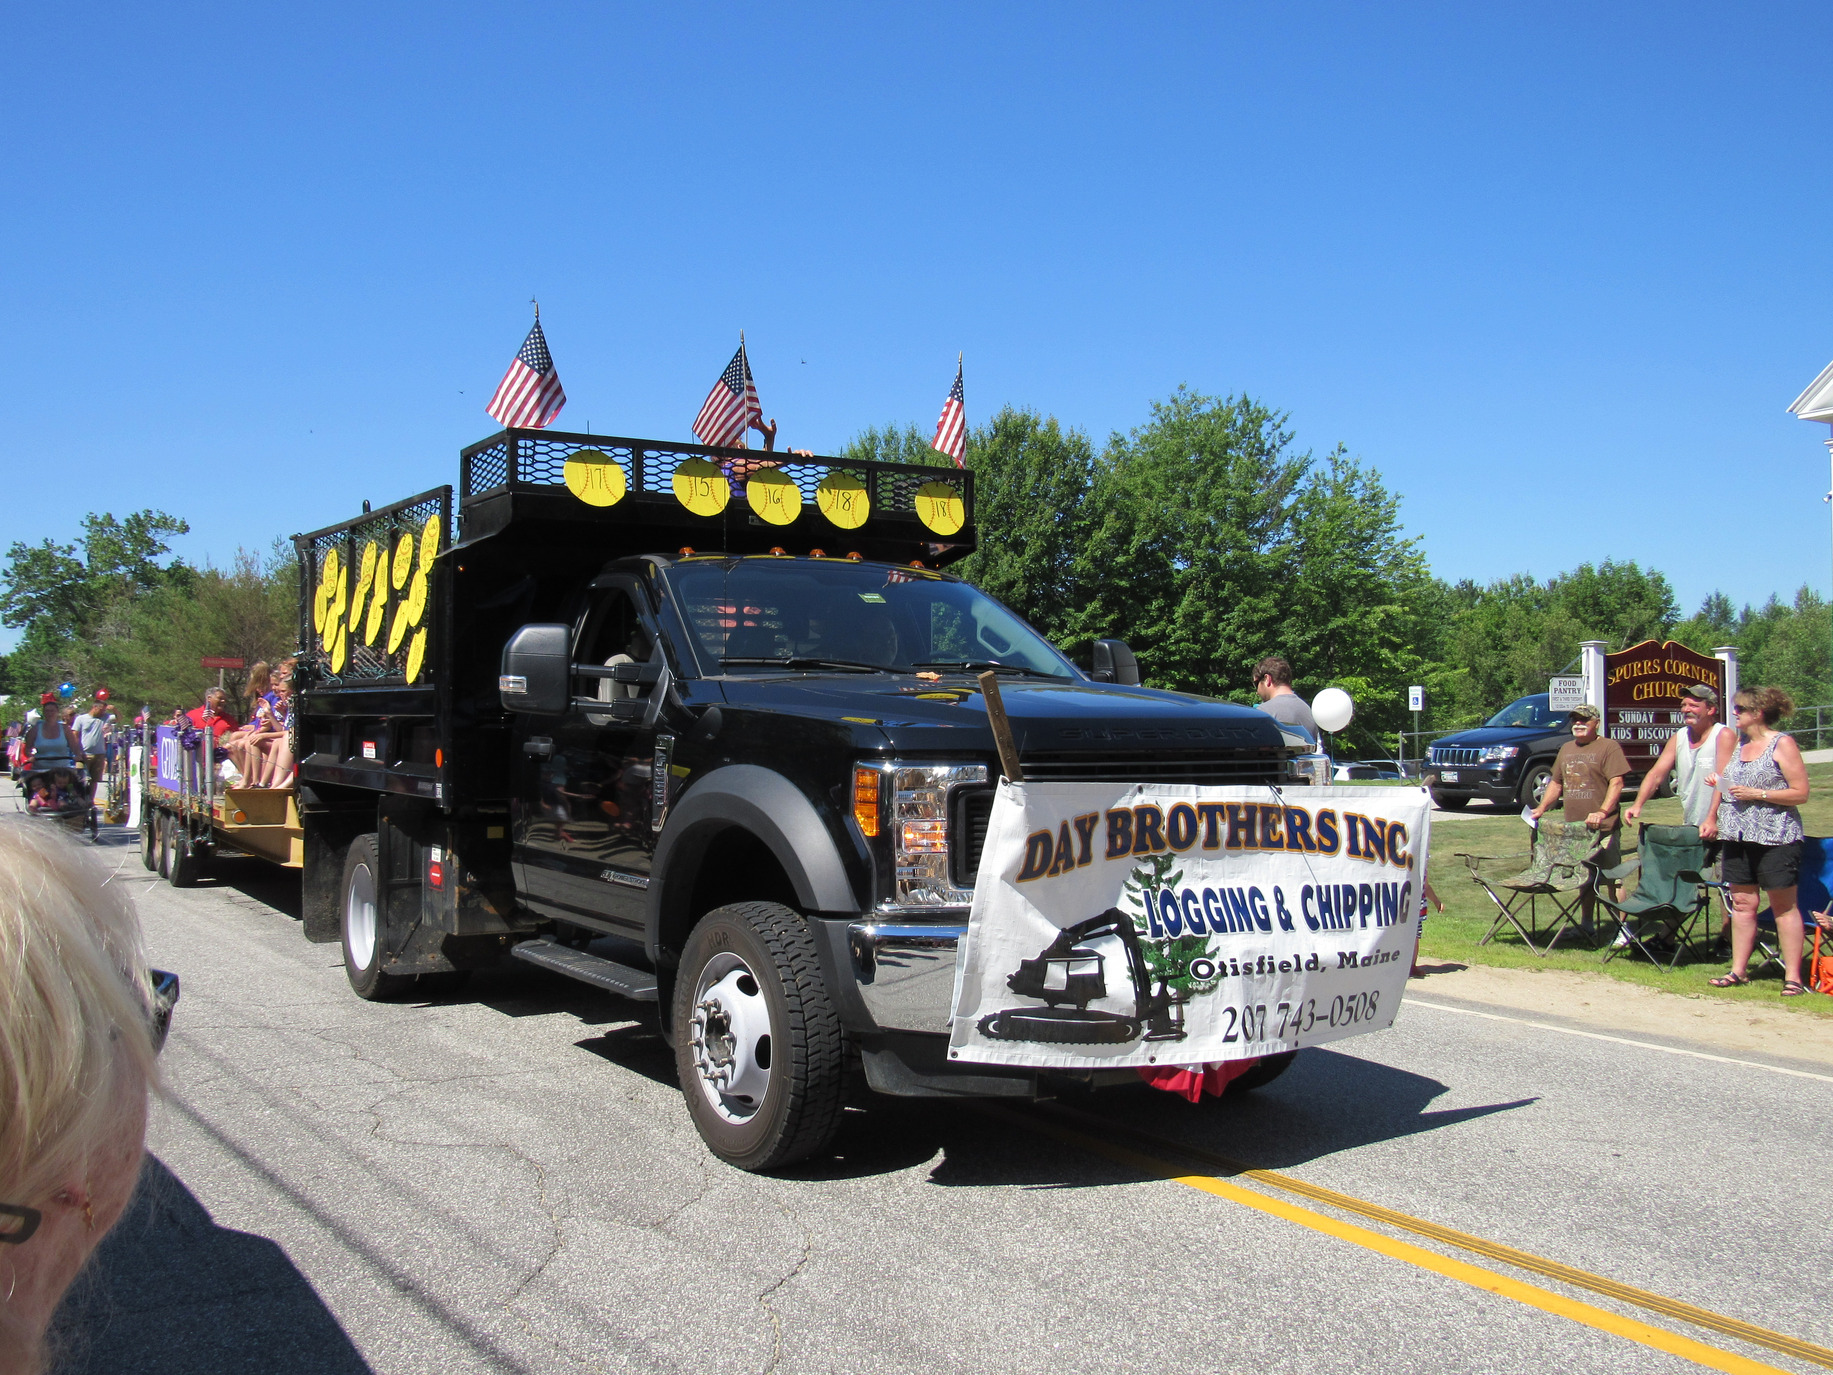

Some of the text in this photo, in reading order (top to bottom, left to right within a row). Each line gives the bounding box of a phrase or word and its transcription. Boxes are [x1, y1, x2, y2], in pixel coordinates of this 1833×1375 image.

[590, 468, 602, 489] 17
[694, 476, 709, 497] 15
[768, 488, 781, 505] 16
[836, 489, 851, 511] 18
[936, 500, 947, 518] 18
[1664, 658, 1718, 689] CORNER
[1553, 687, 1582, 695] PANTRY
[1633, 681, 1692, 701] CHURC
[1619, 711, 1655, 724] SUNDAY
[1186, 727, 1260, 740] DUTY
[1610, 727, 1681, 740] KIDS DISCOVE
[1015, 801, 1414, 883] DAY BROTHERS INC.
[1142, 880, 1412, 939] LOGGING & CHIPPING
[1189, 947, 1401, 982] Otisfield, Maine
[1222, 990, 1380, 1043] 207 743-0508
